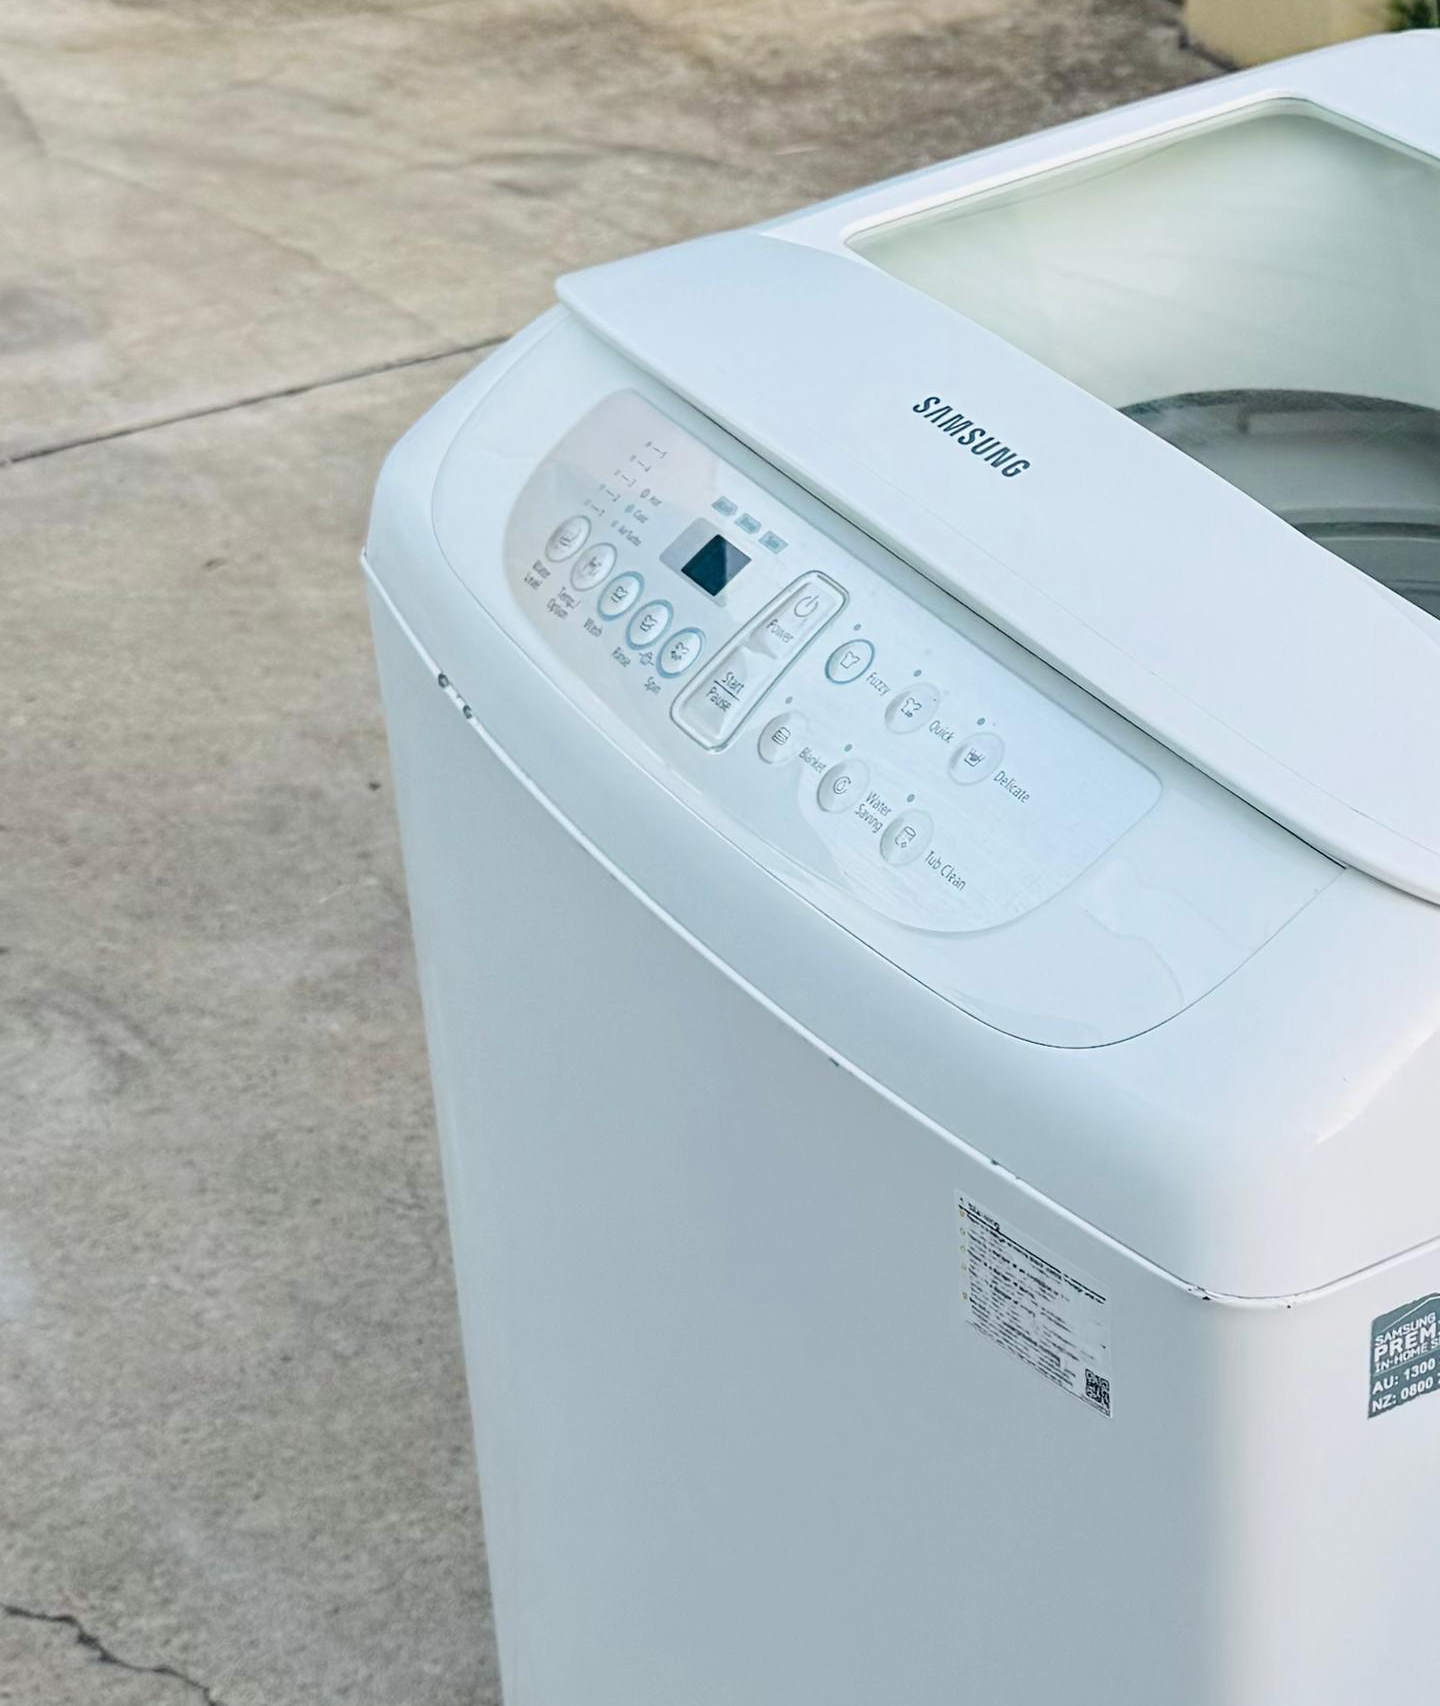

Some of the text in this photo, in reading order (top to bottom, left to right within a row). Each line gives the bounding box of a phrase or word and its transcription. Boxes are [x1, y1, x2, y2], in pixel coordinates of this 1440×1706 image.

[912, 396, 1031, 477] SAMSUNG
[583, 617, 603, 638] Wash
[766, 618, 795, 643] Power
[611, 646, 632, 668] Rinse
[643, 676, 661, 695] Spin
[721, 671, 745, 694] Start
[866, 672, 892, 697] Fuzzy
[706, 686, 732, 712] Pause
[928, 720, 956, 744] Quick
[798, 746, 828, 774] Blanket
[993, 769, 1031, 804] Delicate
[865, 790, 892, 816] Water
[854, 803, 884, 834] Saving
[925, 850, 967, 891] Tub Clean
[1375, 1312, 1436, 1346] SAMSUNG
[1375, 1343, 1429, 1373] IN-HOME
[1372, 1375, 1399, 1395] AU:
[1403, 1358, 1436, 1381] 1300
[1372, 1394, 1397, 1413] NZ:
[1400, 1377, 1434, 1400] 0800
